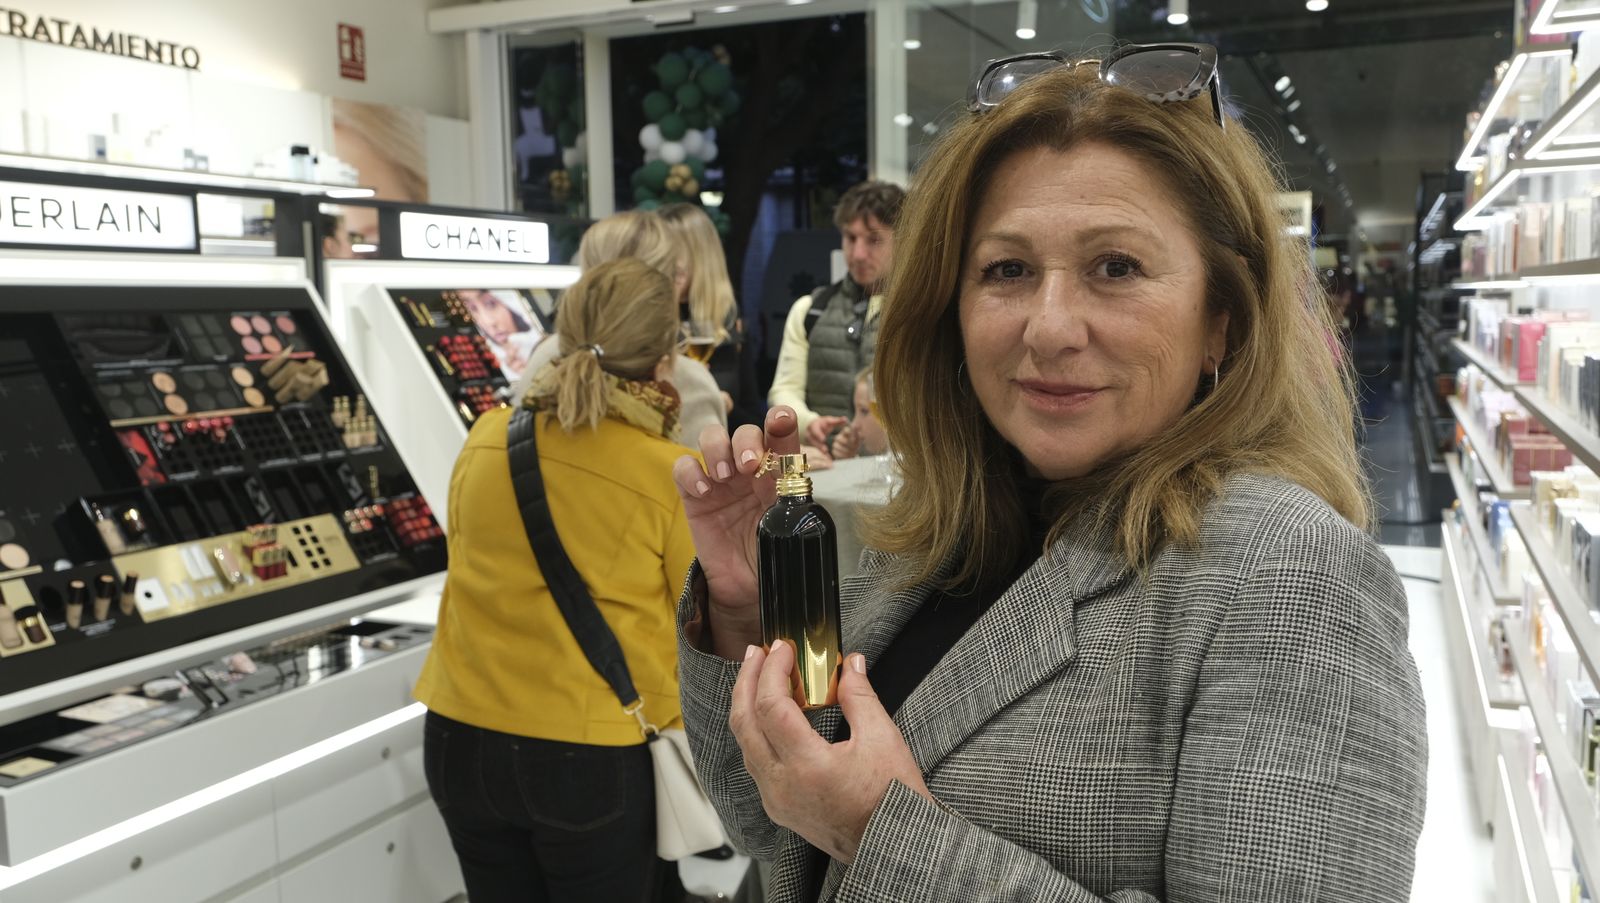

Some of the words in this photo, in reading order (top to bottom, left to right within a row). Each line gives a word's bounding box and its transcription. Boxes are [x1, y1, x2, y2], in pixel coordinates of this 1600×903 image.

[0, 7, 200, 70] RATAMIENTO
[0, 197, 162, 233] ERLAIN
[424, 223, 531, 253] CHANEL
